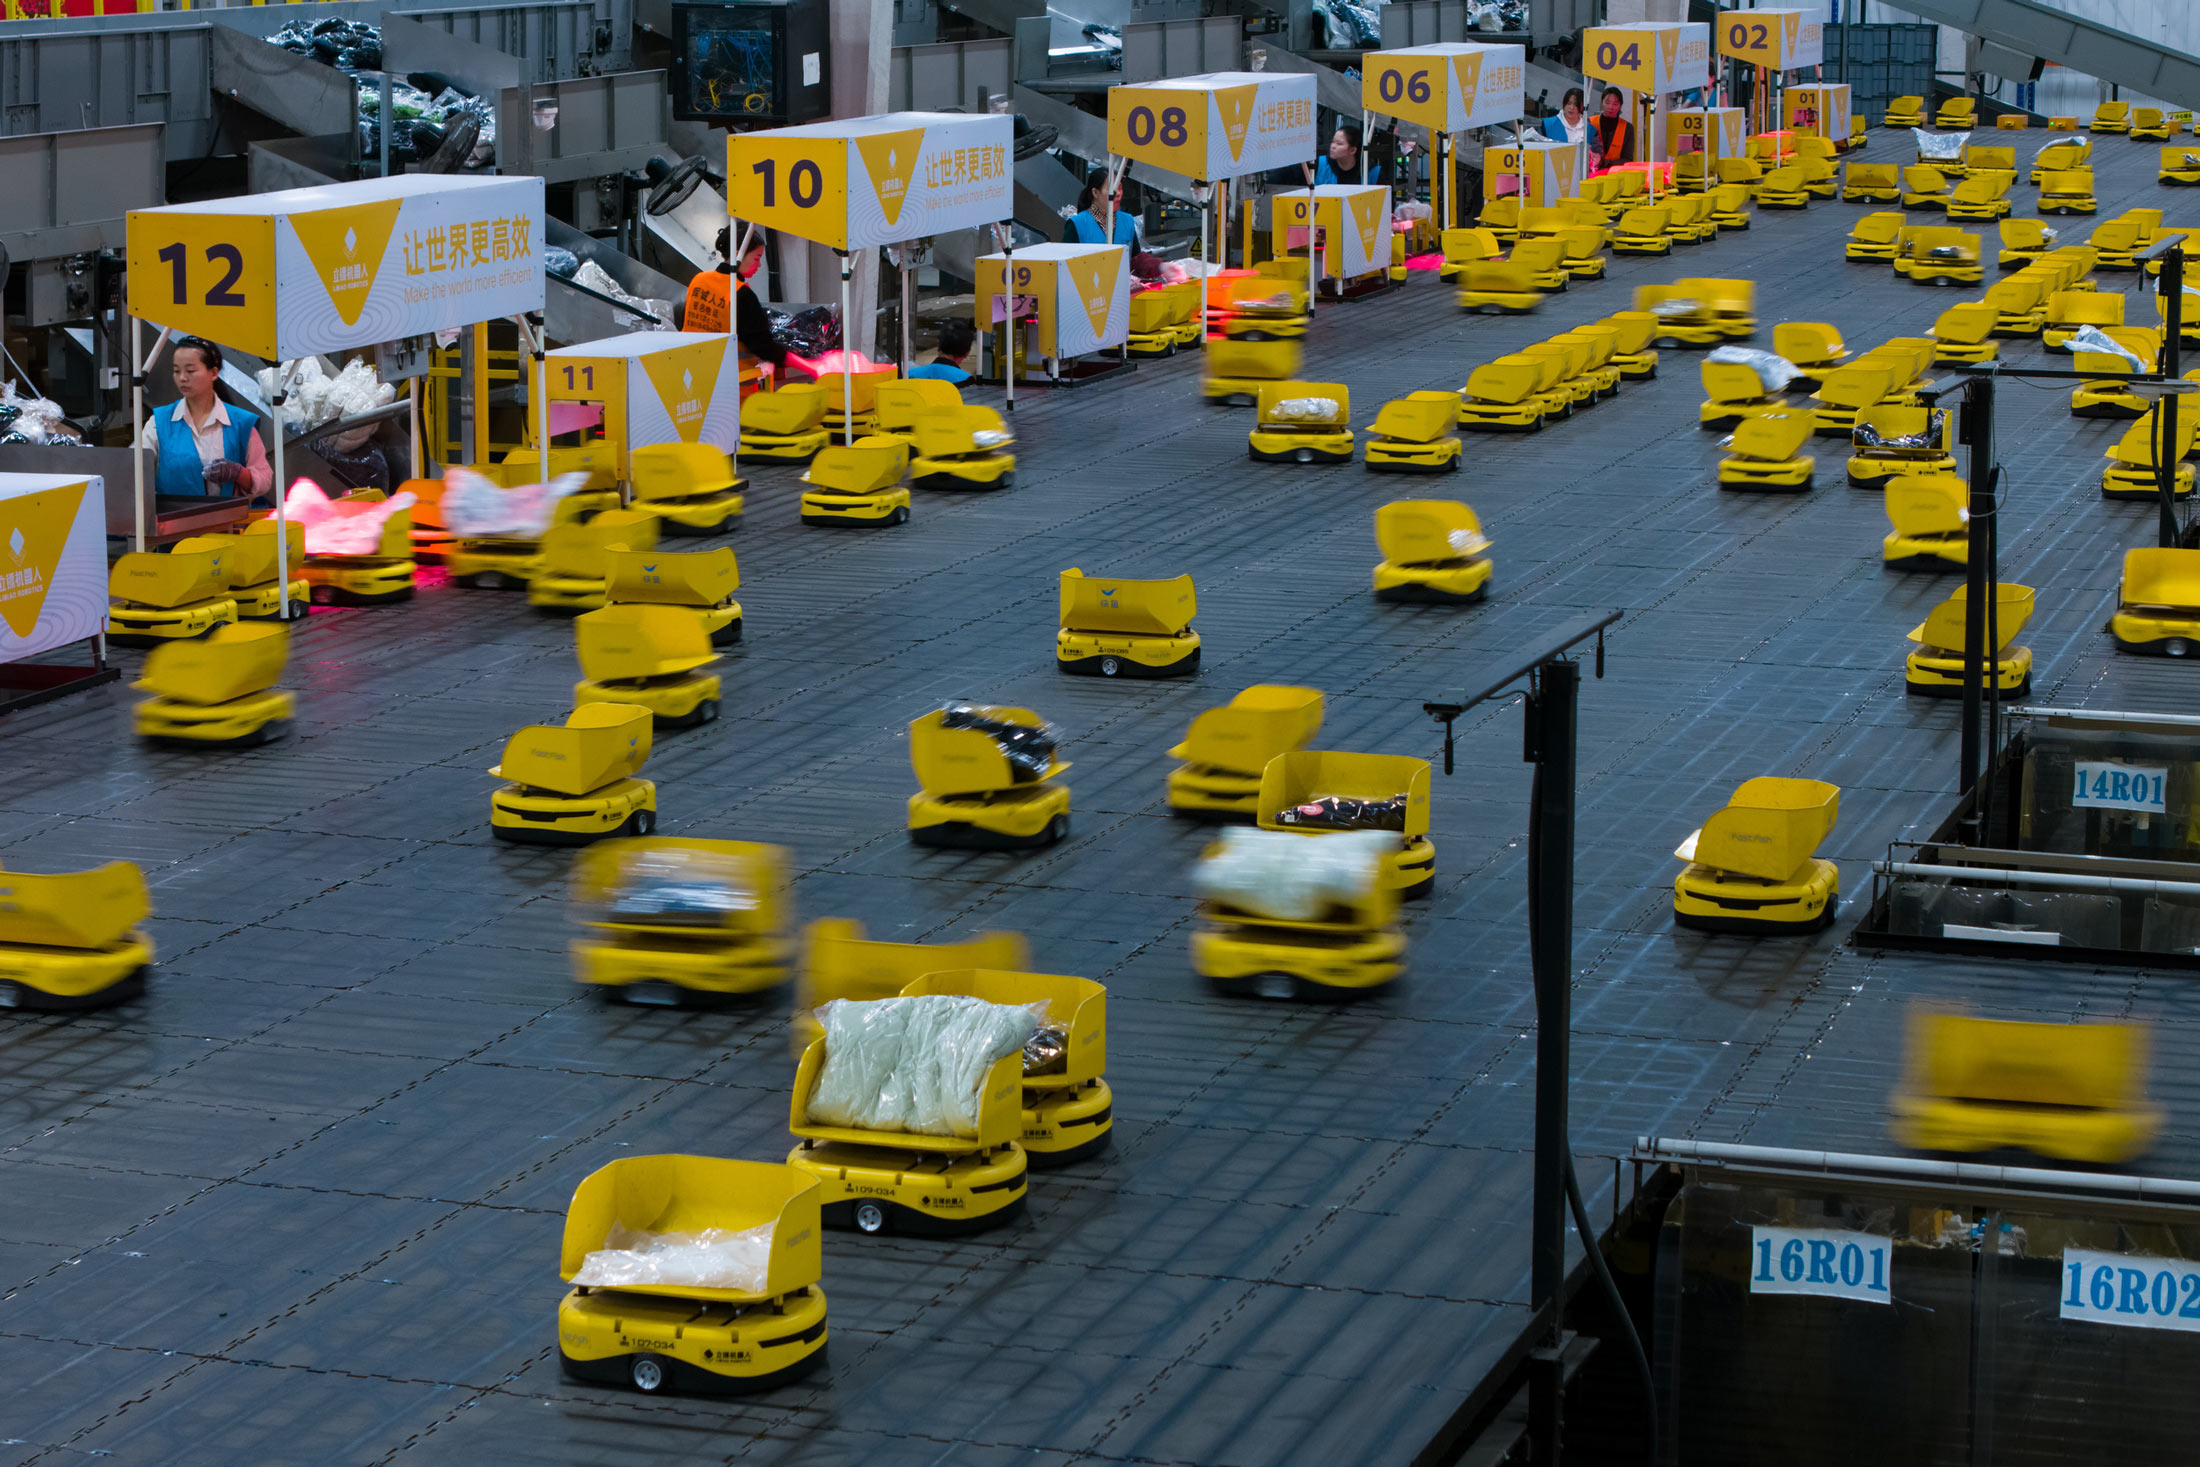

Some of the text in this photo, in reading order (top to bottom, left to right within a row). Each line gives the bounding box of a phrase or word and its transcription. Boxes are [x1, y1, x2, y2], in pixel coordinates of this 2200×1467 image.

[1729, 24, 1768, 49] 02
[1597, 42, 1641, 71] 04
[1379, 69, 1431, 104] 06
[1800, 92, 1815, 104] 01
[1128, 106, 1188, 147] 08
[1258, 97, 1311, 133] 让世界更高效
[1683, 117, 1703, 129] 03
[752, 158, 823, 208] 10
[925, 143, 1005, 188] 让世界更高效
[403, 213, 531, 276] 让世界更高效
[158, 242, 246, 306] 12
[404, 267, 532, 304] Make the world more efficient
[562, 365, 594, 390] 11
[2075, 769, 2164, 805] 14R01
[855, 1186, 896, 1196] 109-034
[1754, 1238, 1888, 1291] 16R01
[2064, 1262, 2200, 1319] 16R02
[631, 1337, 675, 1350] 107-034
